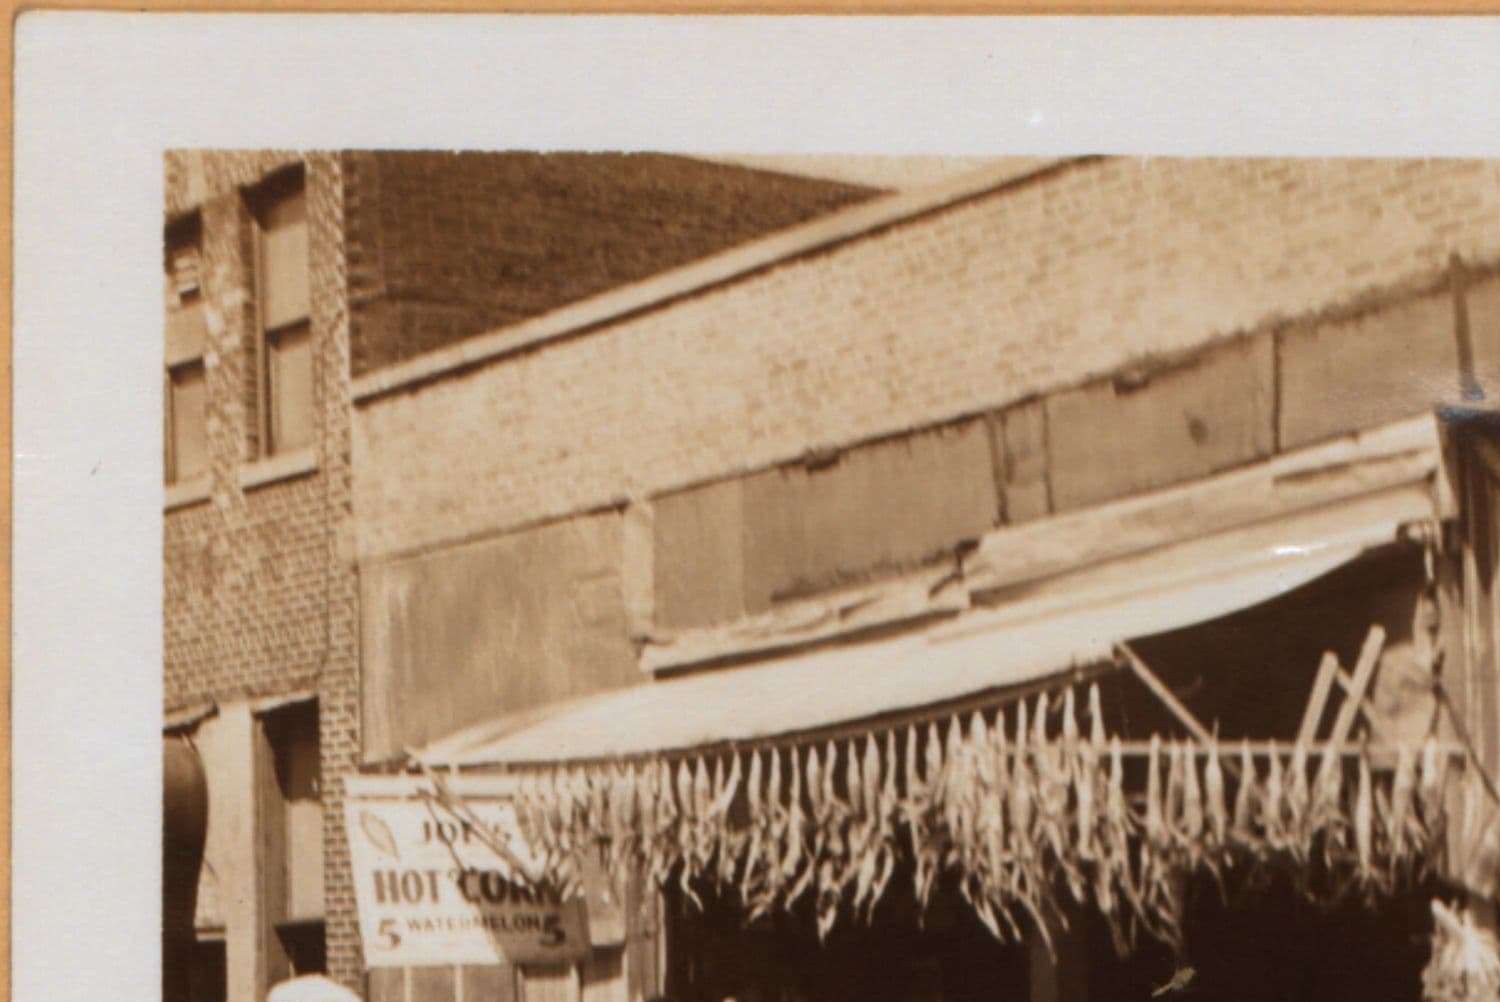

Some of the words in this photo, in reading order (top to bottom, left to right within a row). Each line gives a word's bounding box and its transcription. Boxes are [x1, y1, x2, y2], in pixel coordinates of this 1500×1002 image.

[374, 868, 443, 905] HOT
[379, 918, 402, 950] 5
[406, 913, 541, 932] WATERMELON
